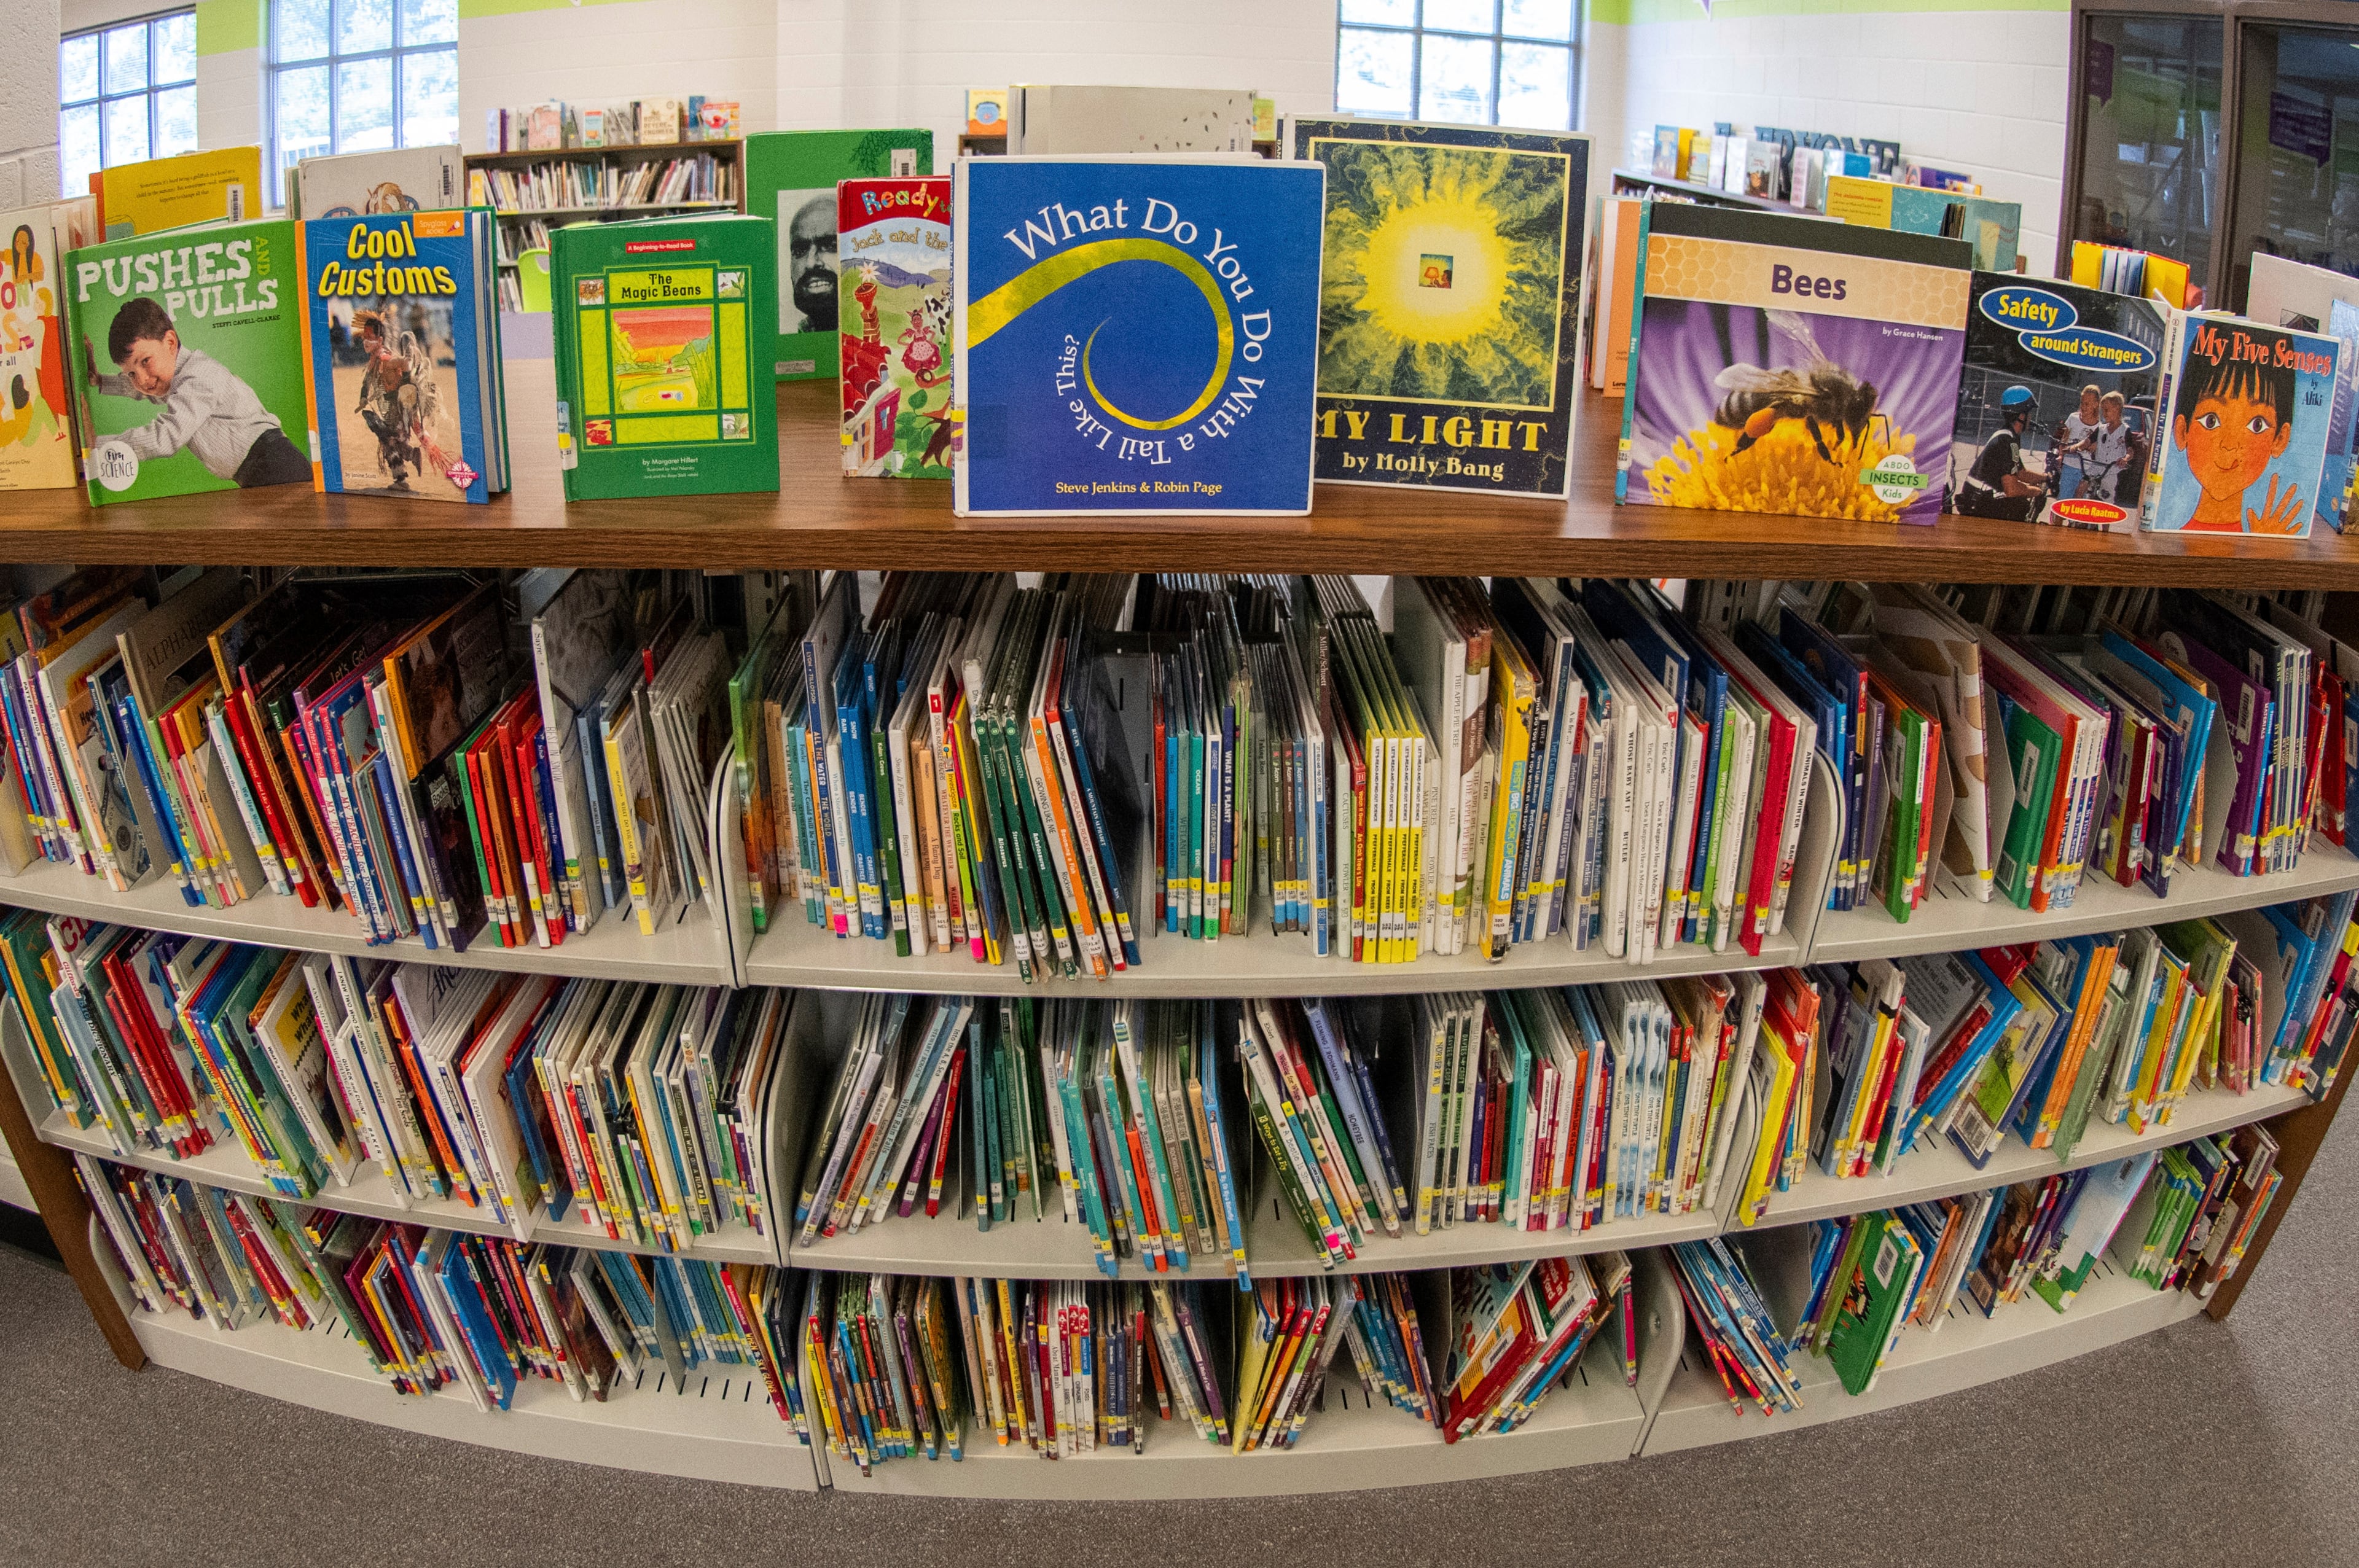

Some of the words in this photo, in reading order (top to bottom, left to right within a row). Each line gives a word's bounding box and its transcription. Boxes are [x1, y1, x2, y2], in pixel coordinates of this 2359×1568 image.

[861, 182, 939, 217] Ready
[1004, 199, 1128, 260] What
[1141, 197, 1197, 244] Do
[347, 221, 417, 259] Cool
[851, 228, 883, 252] Jack
[890, 227, 920, 243] and
[925, 231, 948, 251] the
[76, 239, 252, 302] PUSHES
[256, 236, 270, 276] AND
[1203, 228, 1254, 303] You
[318, 261, 457, 296] Customs
[622, 287, 658, 300] Magic
[663, 285, 701, 296] Beans
[649, 273, 672, 284] The
[1771, 263, 1846, 301] Bees
[165, 279, 278, 322] PULLS
[1998, 294, 2058, 328] Safety
[213, 319, 232, 329] STEFFI
[1242, 309, 1272, 362] Do
[1882, 327, 1892, 337] by
[1893, 329, 1915, 338] Grace
[1917, 332, 1943, 341] Hansen
[1056, 333, 1081, 396] This?
[2030, 335, 2078, 356] around
[2080, 339, 2142, 366] Strangers
[2194, 325, 2228, 366] My
[2231, 330, 2269, 367] Five
[2273, 338, 2332, 377] Senses
[2301, 389, 2322, 408] Aliki
[2310, 378, 2318, 390] by
[1199, 375, 1265, 439] With
[2158, 412, 2167, 424] My
[1070, 398, 1114, 451] Like
[1316, 411, 1370, 440] MY
[1388, 413, 1548, 452] LIGHT
[2155, 425, 2164, 442] Five
[1118, 436, 1172, 466] Tail
[1177, 432, 1195, 451] a
[2151, 442, 2161, 470] Senses
[101, 462, 134, 478] SCIENCE
[1342, 452, 1369, 473] by
[1376, 453, 1439, 475] Molly
[1446, 456, 1504, 482] Bang
[1869, 472, 1920, 486] INSECTS
[1884, 461, 1910, 470] ABDO
[1056, 482, 1089, 494] Steve
[1092, 482, 1136, 494] Jenkins
[1140, 482, 1151, 493] &
[1154, 482, 1189, 493] Robin
[1194, 482, 1222, 495] Page
[1882, 488, 1902, 499] Kids
[2060, 503, 2068, 515] by
[2070, 504, 2089, 517] Lucia
[2091, 505, 2119, 520] Raatma
[808, 674, 816, 704] TILLOTSON
[23, 681, 35, 714] PATTERN
[32, 715, 41, 736] BUGS
[47, 766, 58, 792] HARRIS
[1055, 733, 1067, 766] Cole/Degen
[983, 754, 992, 778] HANSEN
[1226, 774, 1232, 784] IS
[1801, 751, 1812, 787] ANIMALS
[340, 796, 353, 810] MY
[947, 773, 957, 809] Investigate
[1035, 777, 1047, 809] GROWING
[1041, 805, 1051, 824] LIKE
[1047, 823, 1056, 835] ME
[1509, 792, 1521, 809] BIG
[1625, 790, 1631, 802] AM
[1793, 798, 1804, 829] WINTER
[346, 813, 364, 859] TEACHER
[1012, 831, 1023, 869] Styracosaurus
[1032, 832, 1046, 870] Ankylosaurus
[998, 837, 1007, 868] Allosaurus
[867, 856, 875, 884] CRABTREE
[1061, 871, 1073, 897] Rockwell
[1498, 859, 1515, 902] ANIMALS
[362, 875, 379, 917] PRESIDENT
[1263, 1021, 1275, 1040] Ehlert
[87, 1021, 117, 1078] DICTIONARY
[1315, 1020, 1328, 1046] FLEMING
[1326, 1050, 1340, 1082] ROHMANN
[342, 1058, 353, 1081] QUACK
[356, 1095, 367, 1116] COUNT
[1279, 1053, 1289, 1077] Waiting
[1290, 1083, 1302, 1102] Wings
[471, 1098, 486, 1132] ELEVATOR
[481, 1131, 491, 1149] MAGIC
[898, 1098, 910, 1118] When
[367, 1127, 381, 1155] BAKER
[889, 1118, 901, 1135] Rain
[1348, 1112, 1364, 1145] HONEYBEE
[882, 1137, 894, 1154] Falls
[495, 1171, 506, 1194] MURPHY
[746, 1333, 757, 1351] WHEN
[757, 1358, 767, 1370] SKY
